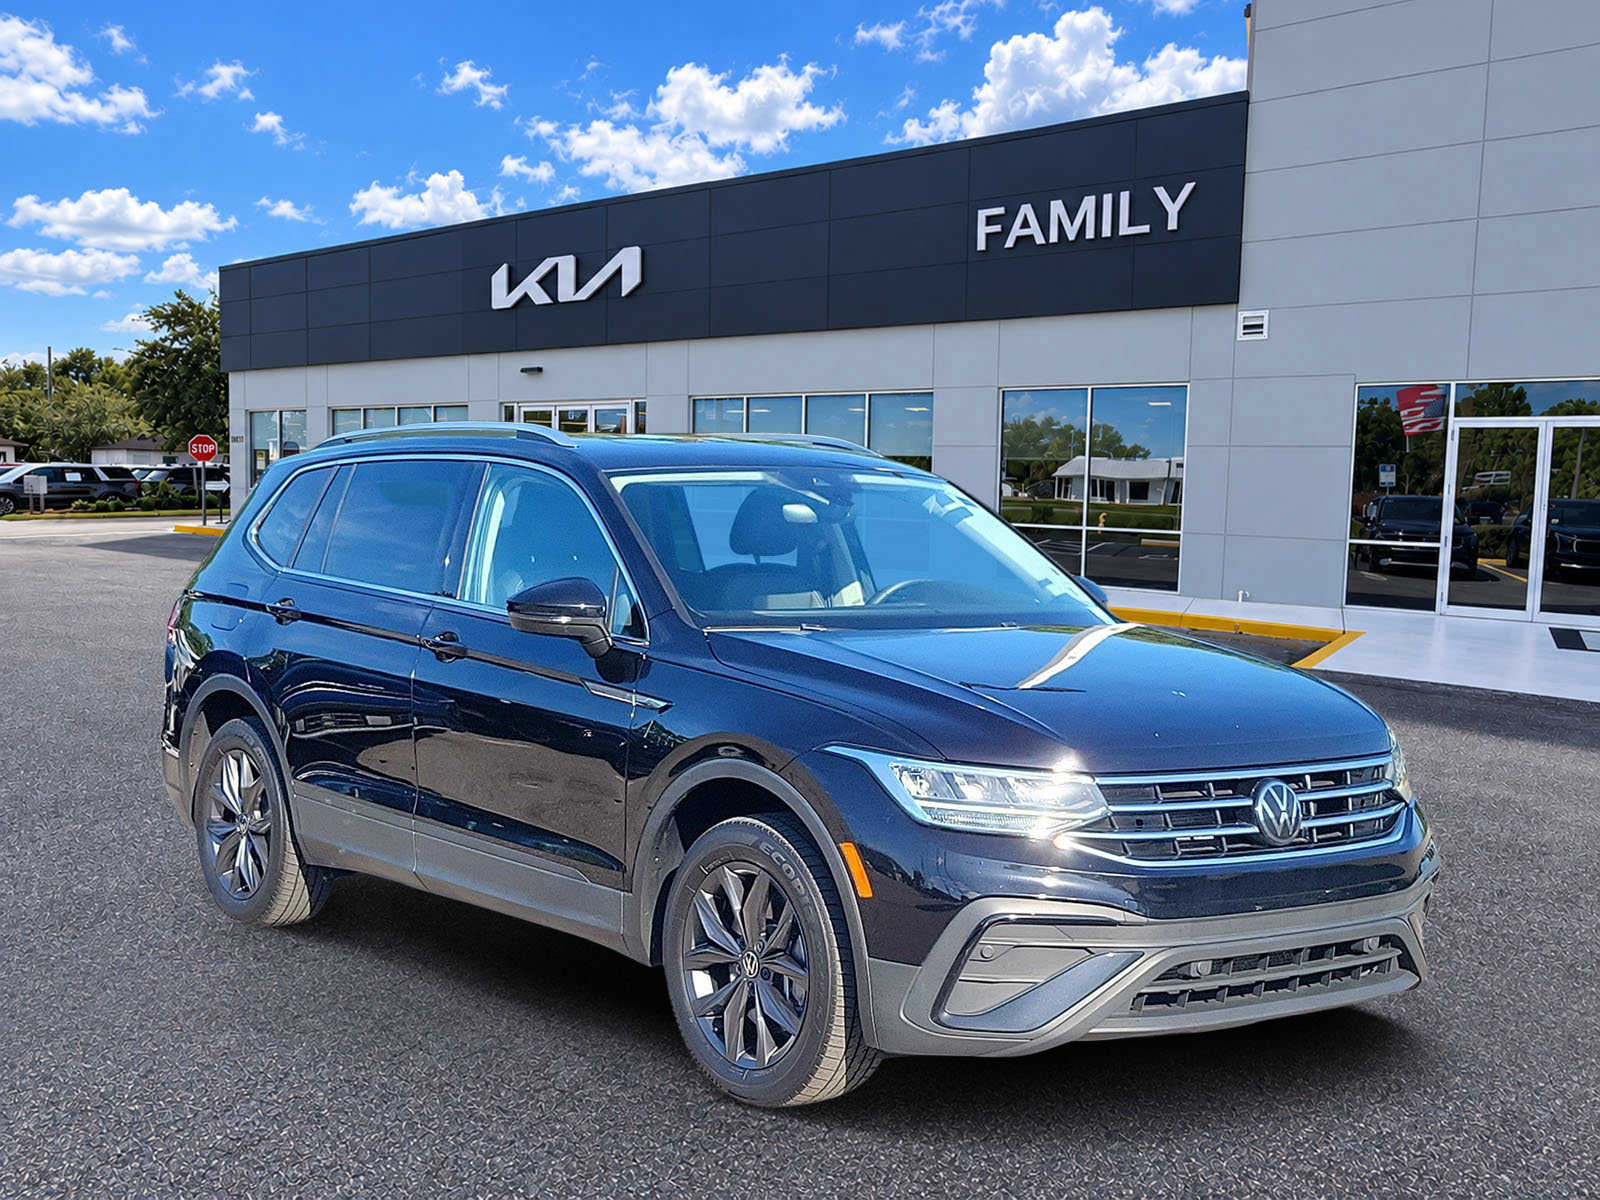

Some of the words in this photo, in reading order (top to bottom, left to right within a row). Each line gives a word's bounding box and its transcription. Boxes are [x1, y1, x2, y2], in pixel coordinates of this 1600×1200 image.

[977, 181, 1196, 251] FAMILY
[491, 246, 642, 310] KIA
[191, 443, 215, 454] STOP
